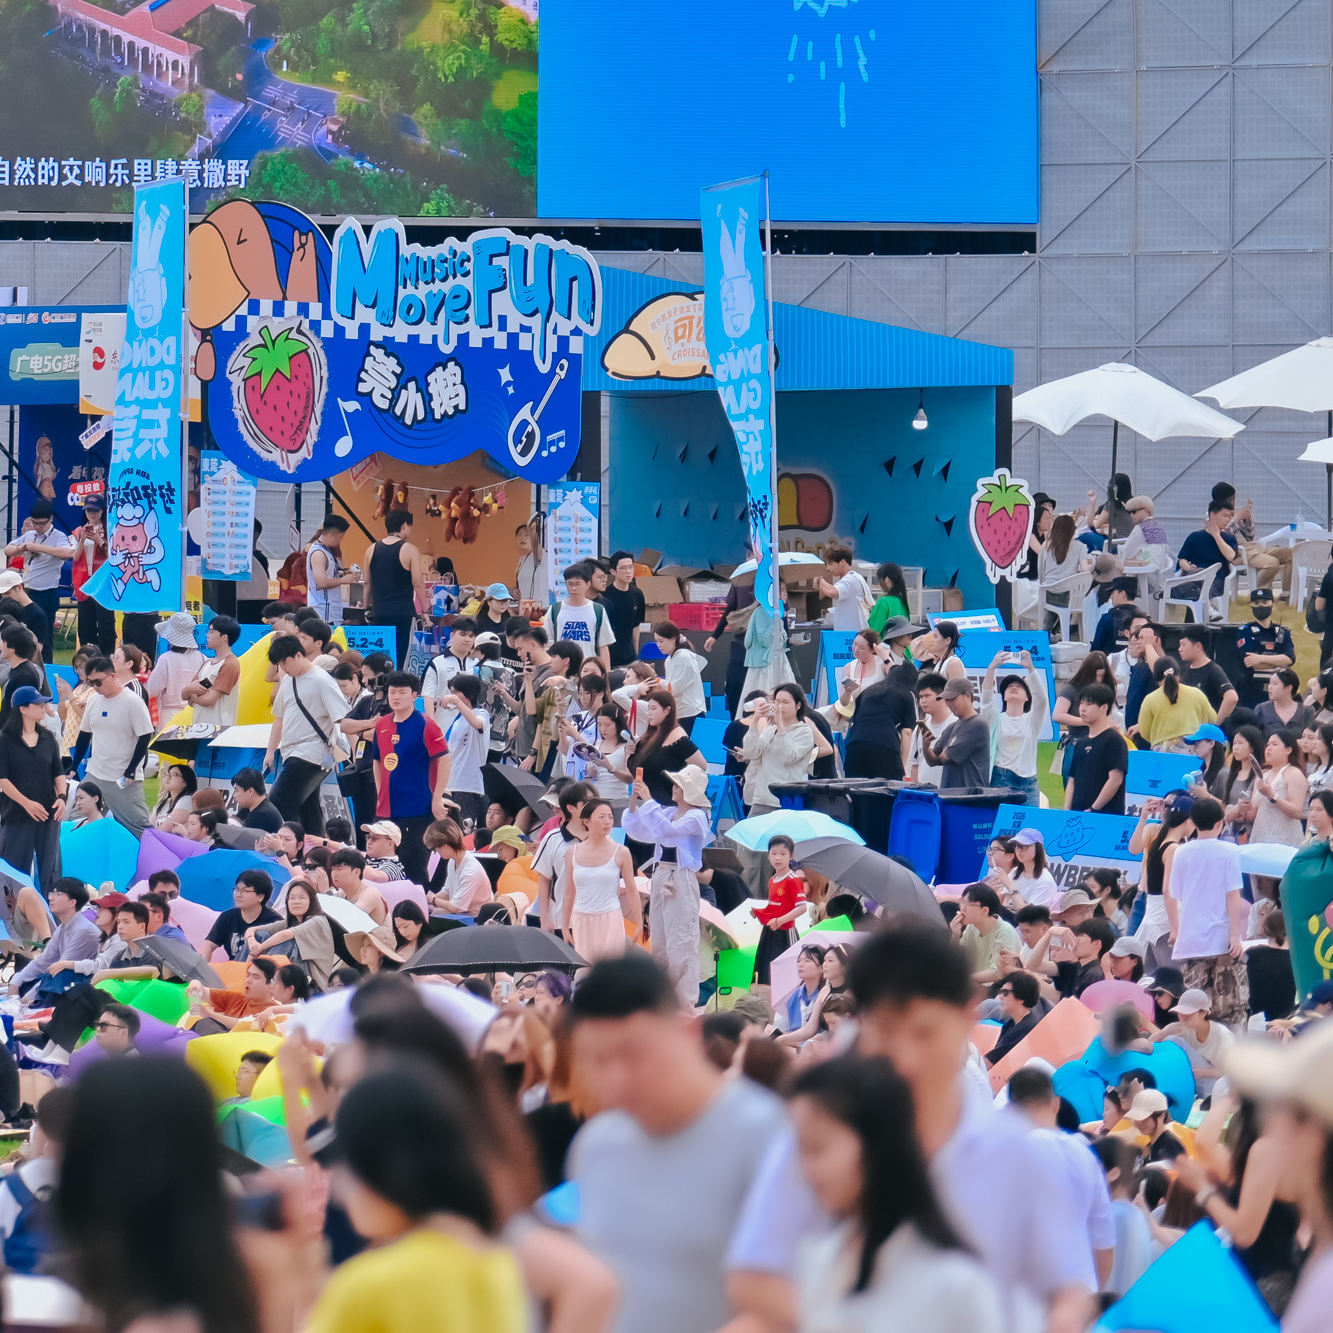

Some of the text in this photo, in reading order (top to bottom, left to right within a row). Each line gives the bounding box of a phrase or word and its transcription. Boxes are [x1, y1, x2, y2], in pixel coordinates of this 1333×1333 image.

[398, 246, 472, 289] Music
[472, 236, 596, 329] Fun
[672, 344, 709, 361] CROISSA
[15, 353, 80, 375] 广电5G超
[358, 344, 468, 426] 莞小鹅
[289, 386, 312, 447] STRAWBERRY
[563, 621, 589, 630] STAR
[347, 637, 384, 649] 5.2-4
[560, 629, 592, 642] WARS
